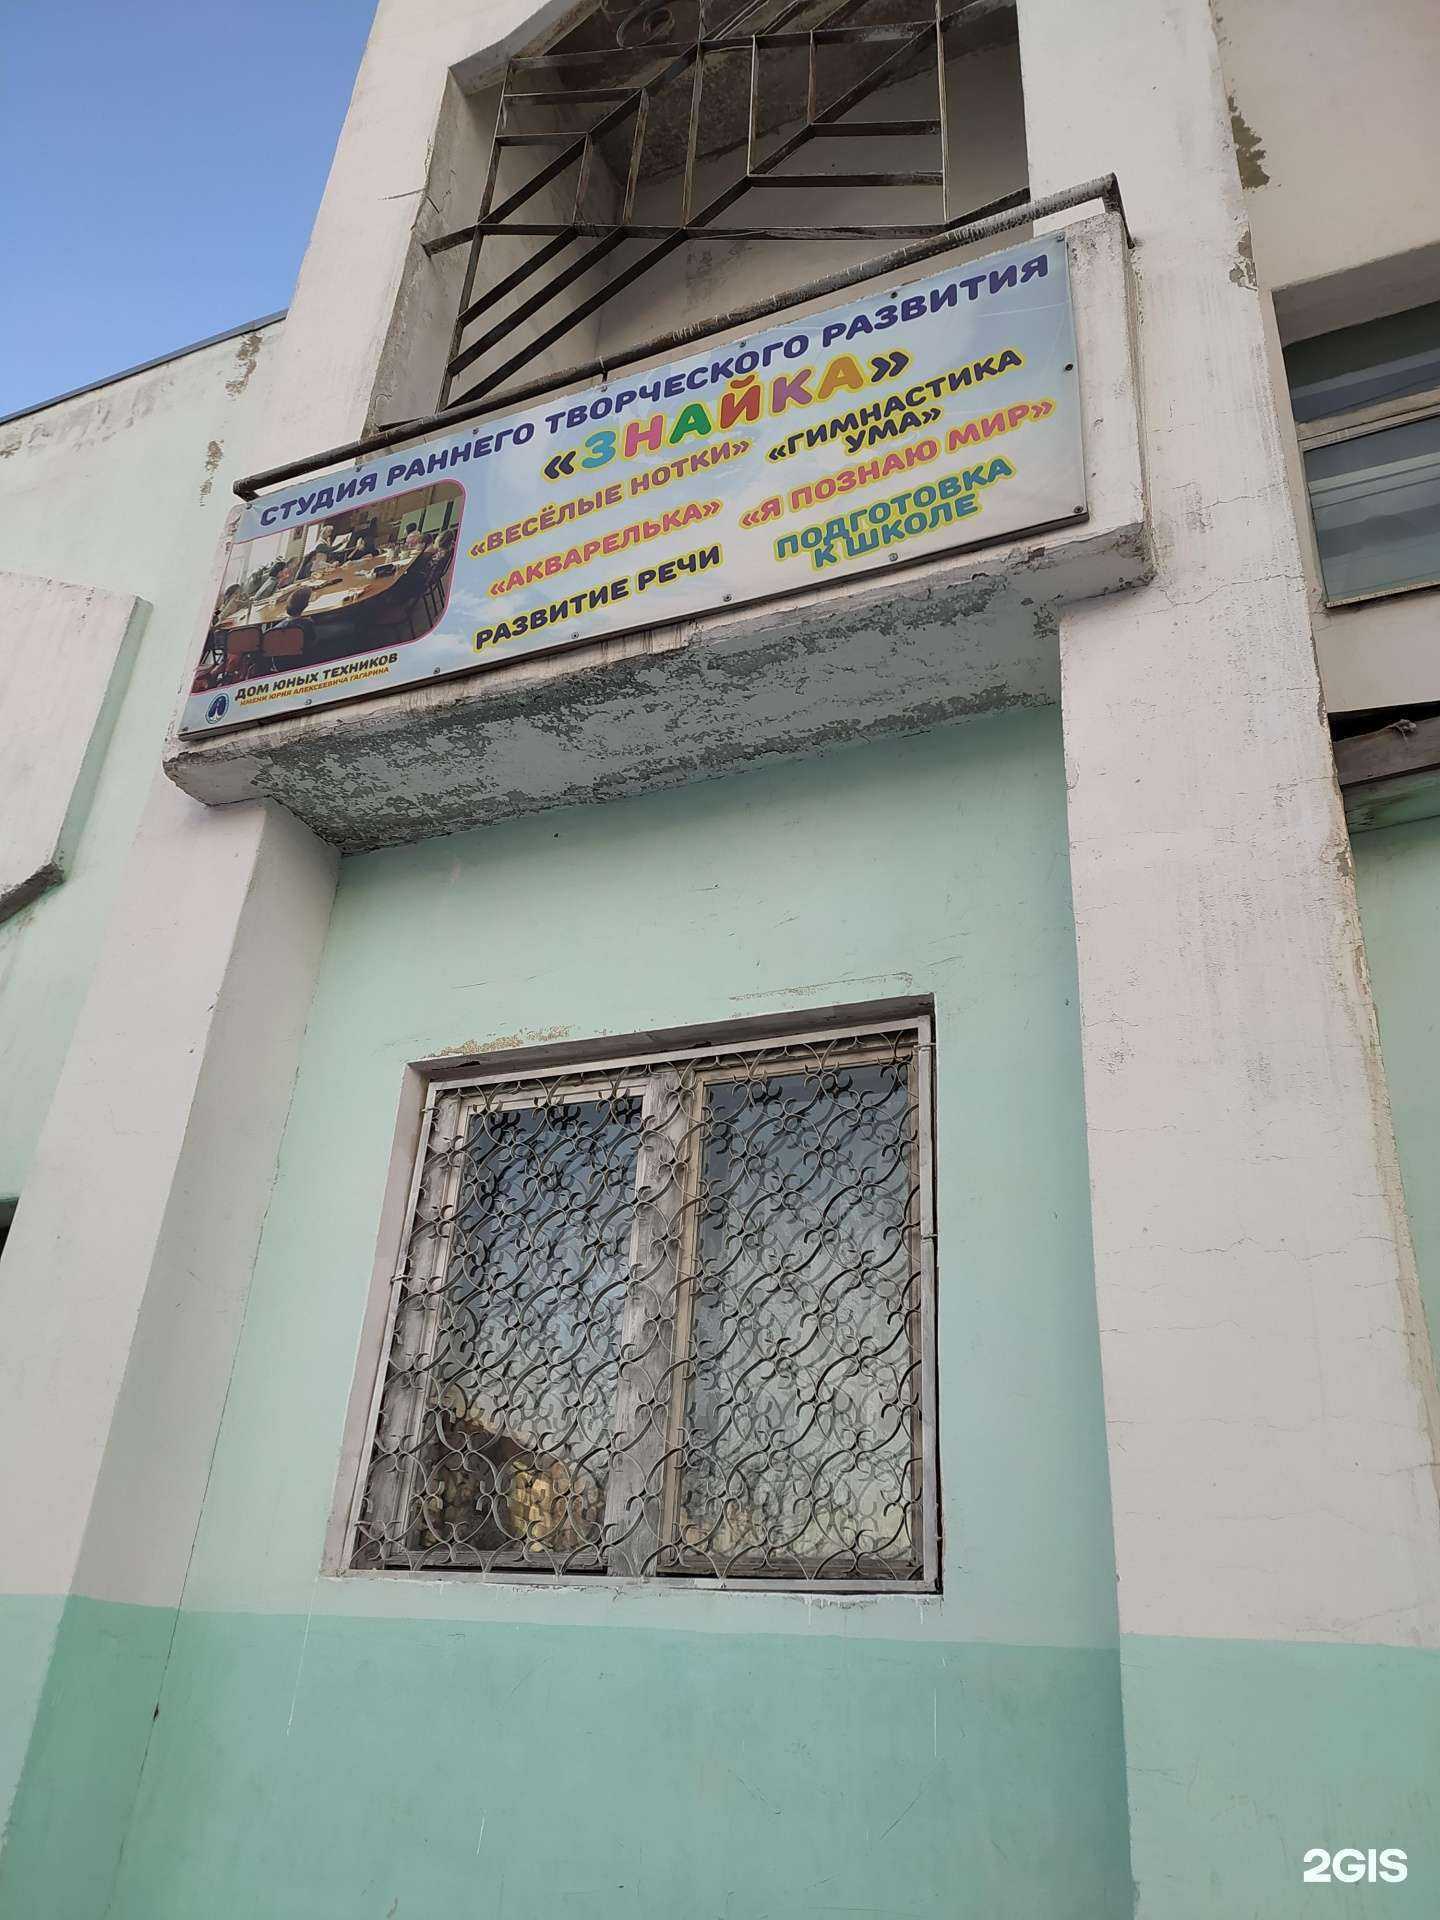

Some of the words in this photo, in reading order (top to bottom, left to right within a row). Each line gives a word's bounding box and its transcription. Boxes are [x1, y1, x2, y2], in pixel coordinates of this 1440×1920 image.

[259, 473, 377, 527] СТУДИЯ
[386, 422, 535, 487] РАННЕГО
[545, 333, 809, 434] ТВОРЧЕСКОГО
[822, 254, 1048, 347] РАЗВИТИЯ
[544, 351, 909, 479] «ЗНАЙКА»
[768, 350, 1022, 462] «ГИМНАСТИКА
[847, 407, 941, 453] УМА»
[470, 483, 623, 556] «ВЕСЁЛЫЕ
[631, 440, 750, 495] НОТКИ»
[742, 497, 781, 526] «Я
[792, 439, 937, 507] ПОЗНАЮ
[949, 401, 1053, 451] МИР»
[778, 458, 1013, 558] ПОДГОТОВКА
[490, 501, 721, 596] «АКВАРЕЛЬКА»
[815, 544, 837, 569] К
[847, 493, 978, 556] ШКОЛЕ
[476, 578, 629, 650] РАЗВИТИЕ
[638, 546, 720, 591] РЕЧИ
[235, 684, 269, 701] ДОМ
[273, 672, 319, 691] ЮНЫХ
[323, 652, 398, 680] ТЕХНИКОВ
[269, 689, 292, 700] ЮРИЯ
[293, 677, 349, 696] АЛЕКСЕЕВИЧА
[350, 666, 389, 682] ГАГАРИНА
